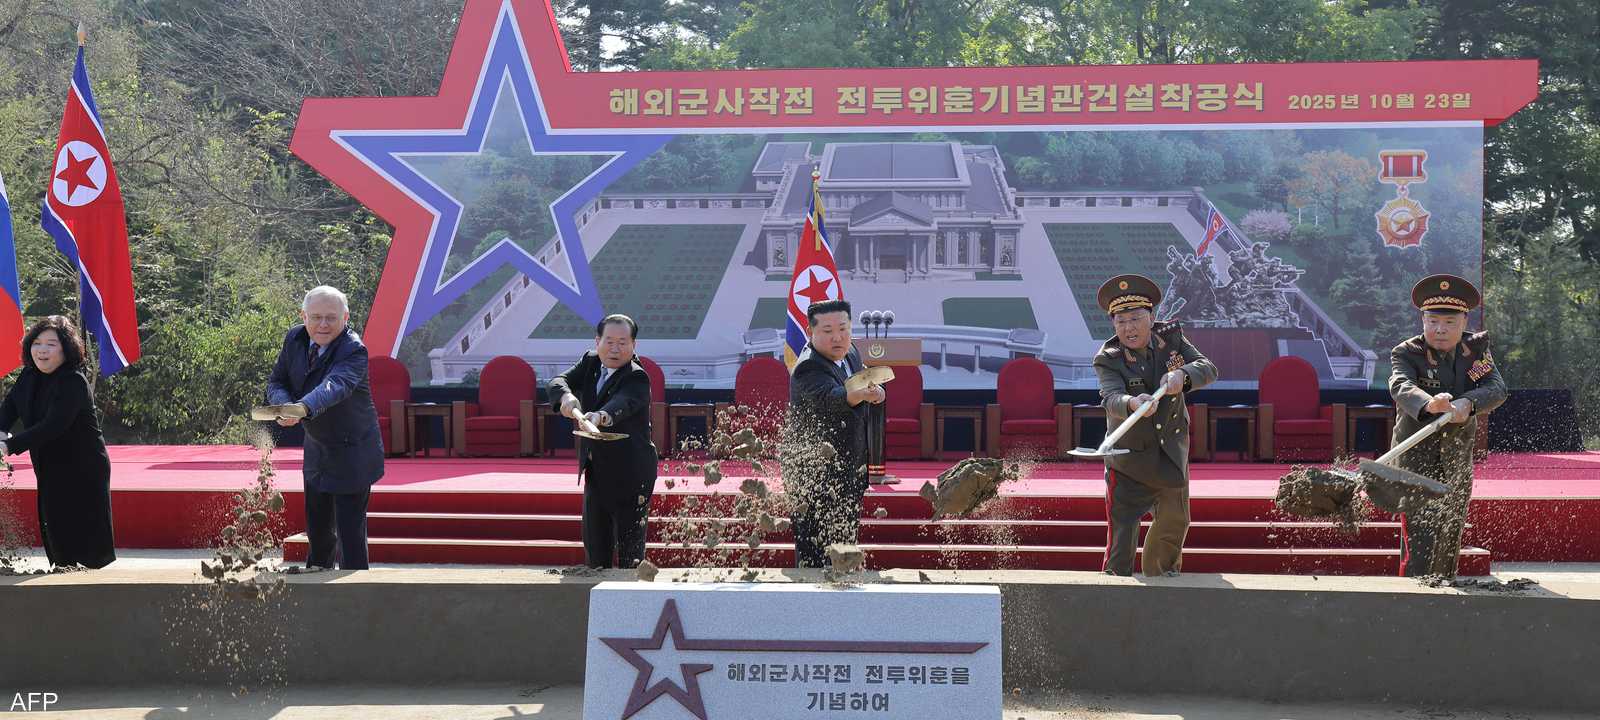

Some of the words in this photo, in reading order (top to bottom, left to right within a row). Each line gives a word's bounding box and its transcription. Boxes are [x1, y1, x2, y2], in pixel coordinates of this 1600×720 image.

[609, 87, 814, 116] 해외군사작전
[837, 82, 1265, 117] 전투위훈기념관건설착공식
[1369, 94, 1415, 109] 10월
[1424, 93, 1472, 109] 23일
[727, 664, 852, 684] 해외군사작전
[865, 665, 970, 685] 전투위훈을
[807, 692, 890, 712] 기념하여
